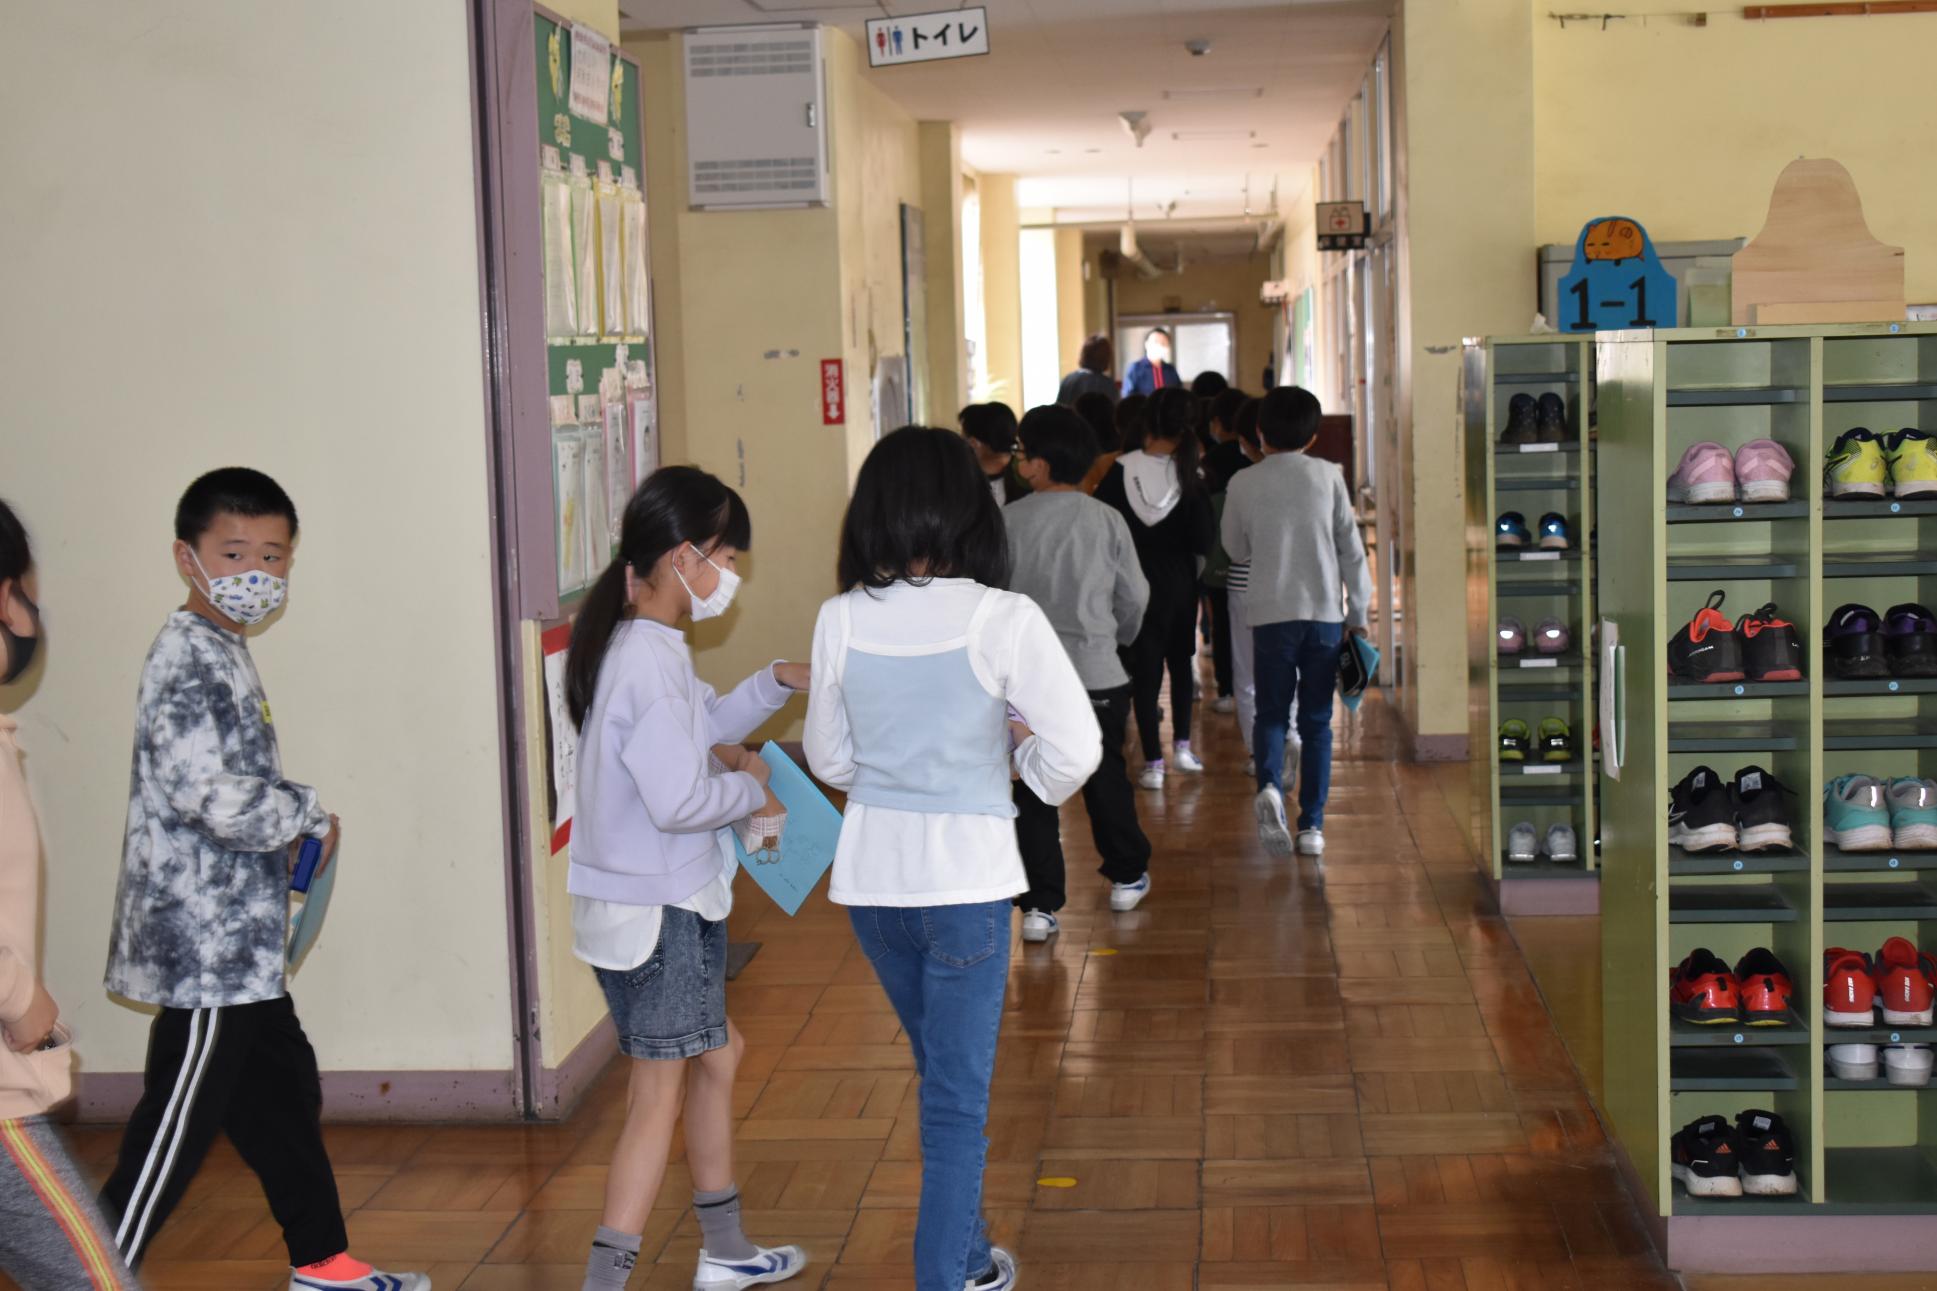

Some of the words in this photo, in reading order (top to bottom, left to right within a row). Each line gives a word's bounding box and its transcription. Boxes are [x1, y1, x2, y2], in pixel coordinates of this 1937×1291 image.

[912, 22, 979, 50] トイレ
[1570, 275, 1656, 330] 1-1
